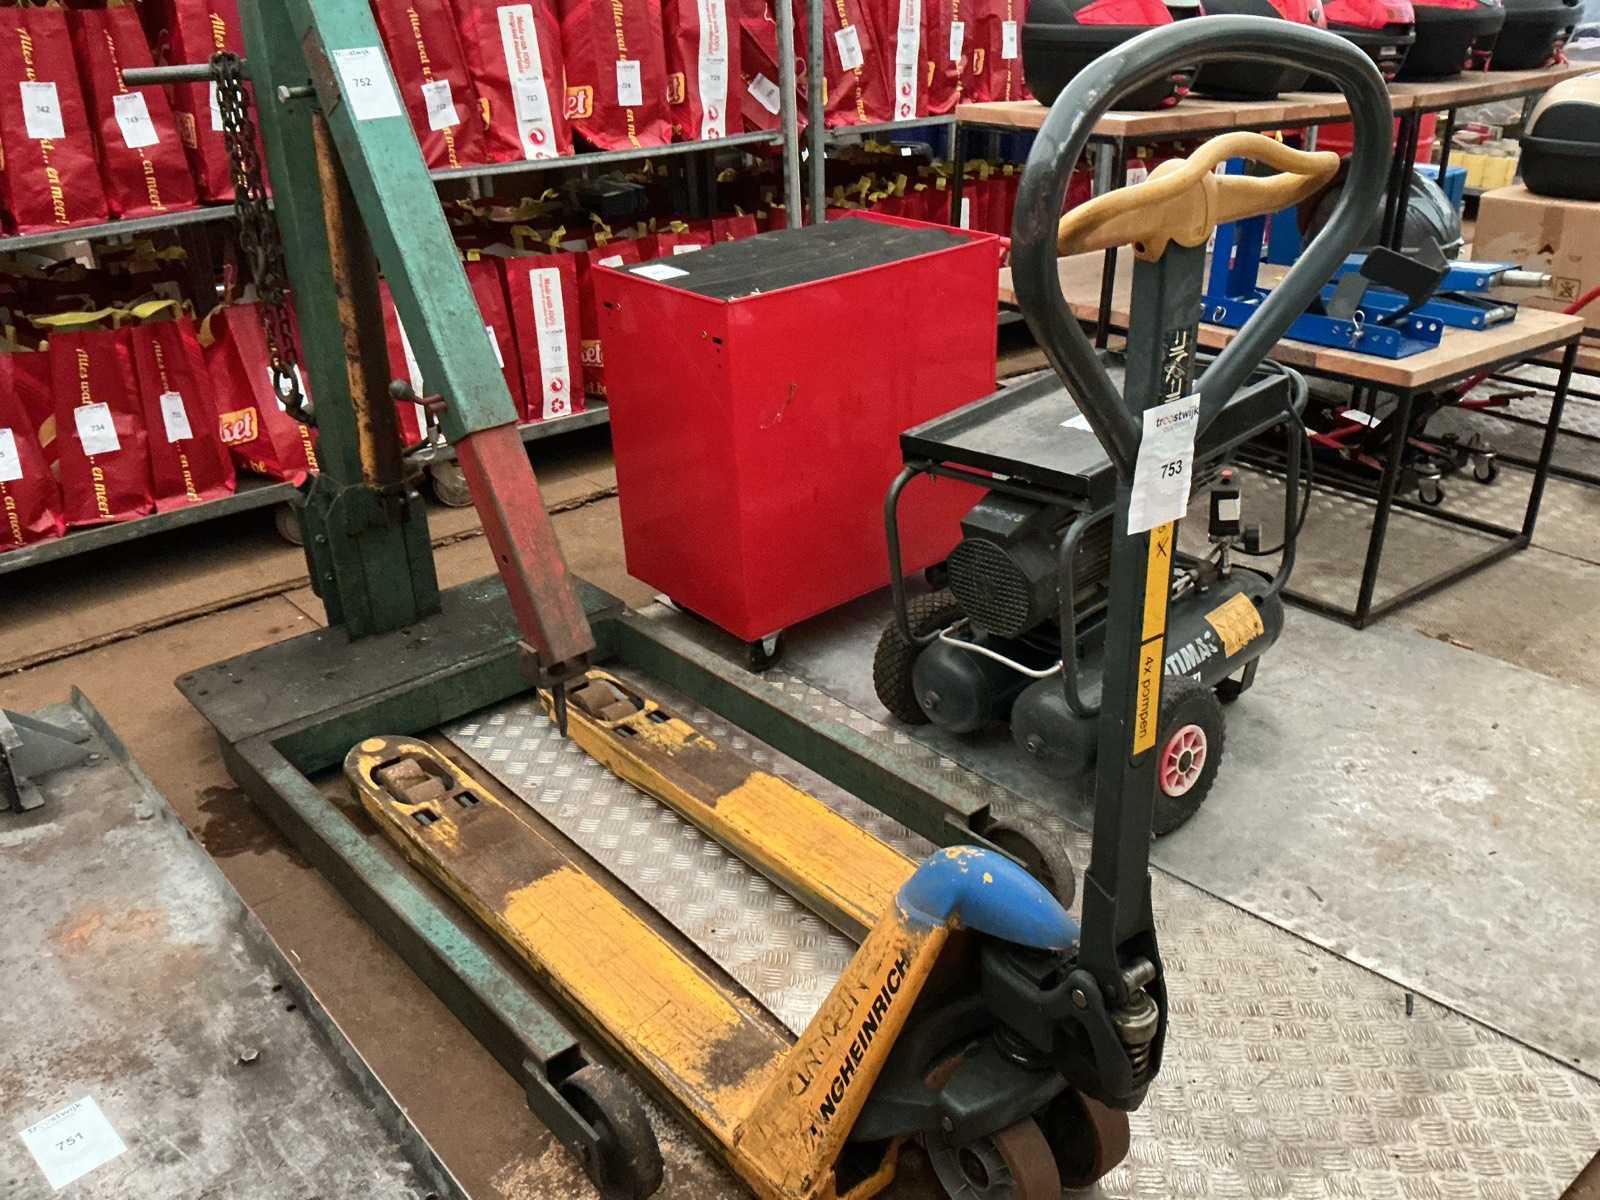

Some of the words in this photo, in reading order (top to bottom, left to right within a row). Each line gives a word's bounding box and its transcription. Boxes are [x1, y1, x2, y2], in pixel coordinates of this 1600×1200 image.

[352, 77, 372, 87] 752
[46, 166, 59, 184] en
[51, 184, 70, 224] meer!
[91, 467, 104, 483] en
[1161, 460, 1183, 479] 753
[95, 483, 115, 519] meer!
[56, 1132, 84, 1151] 751
